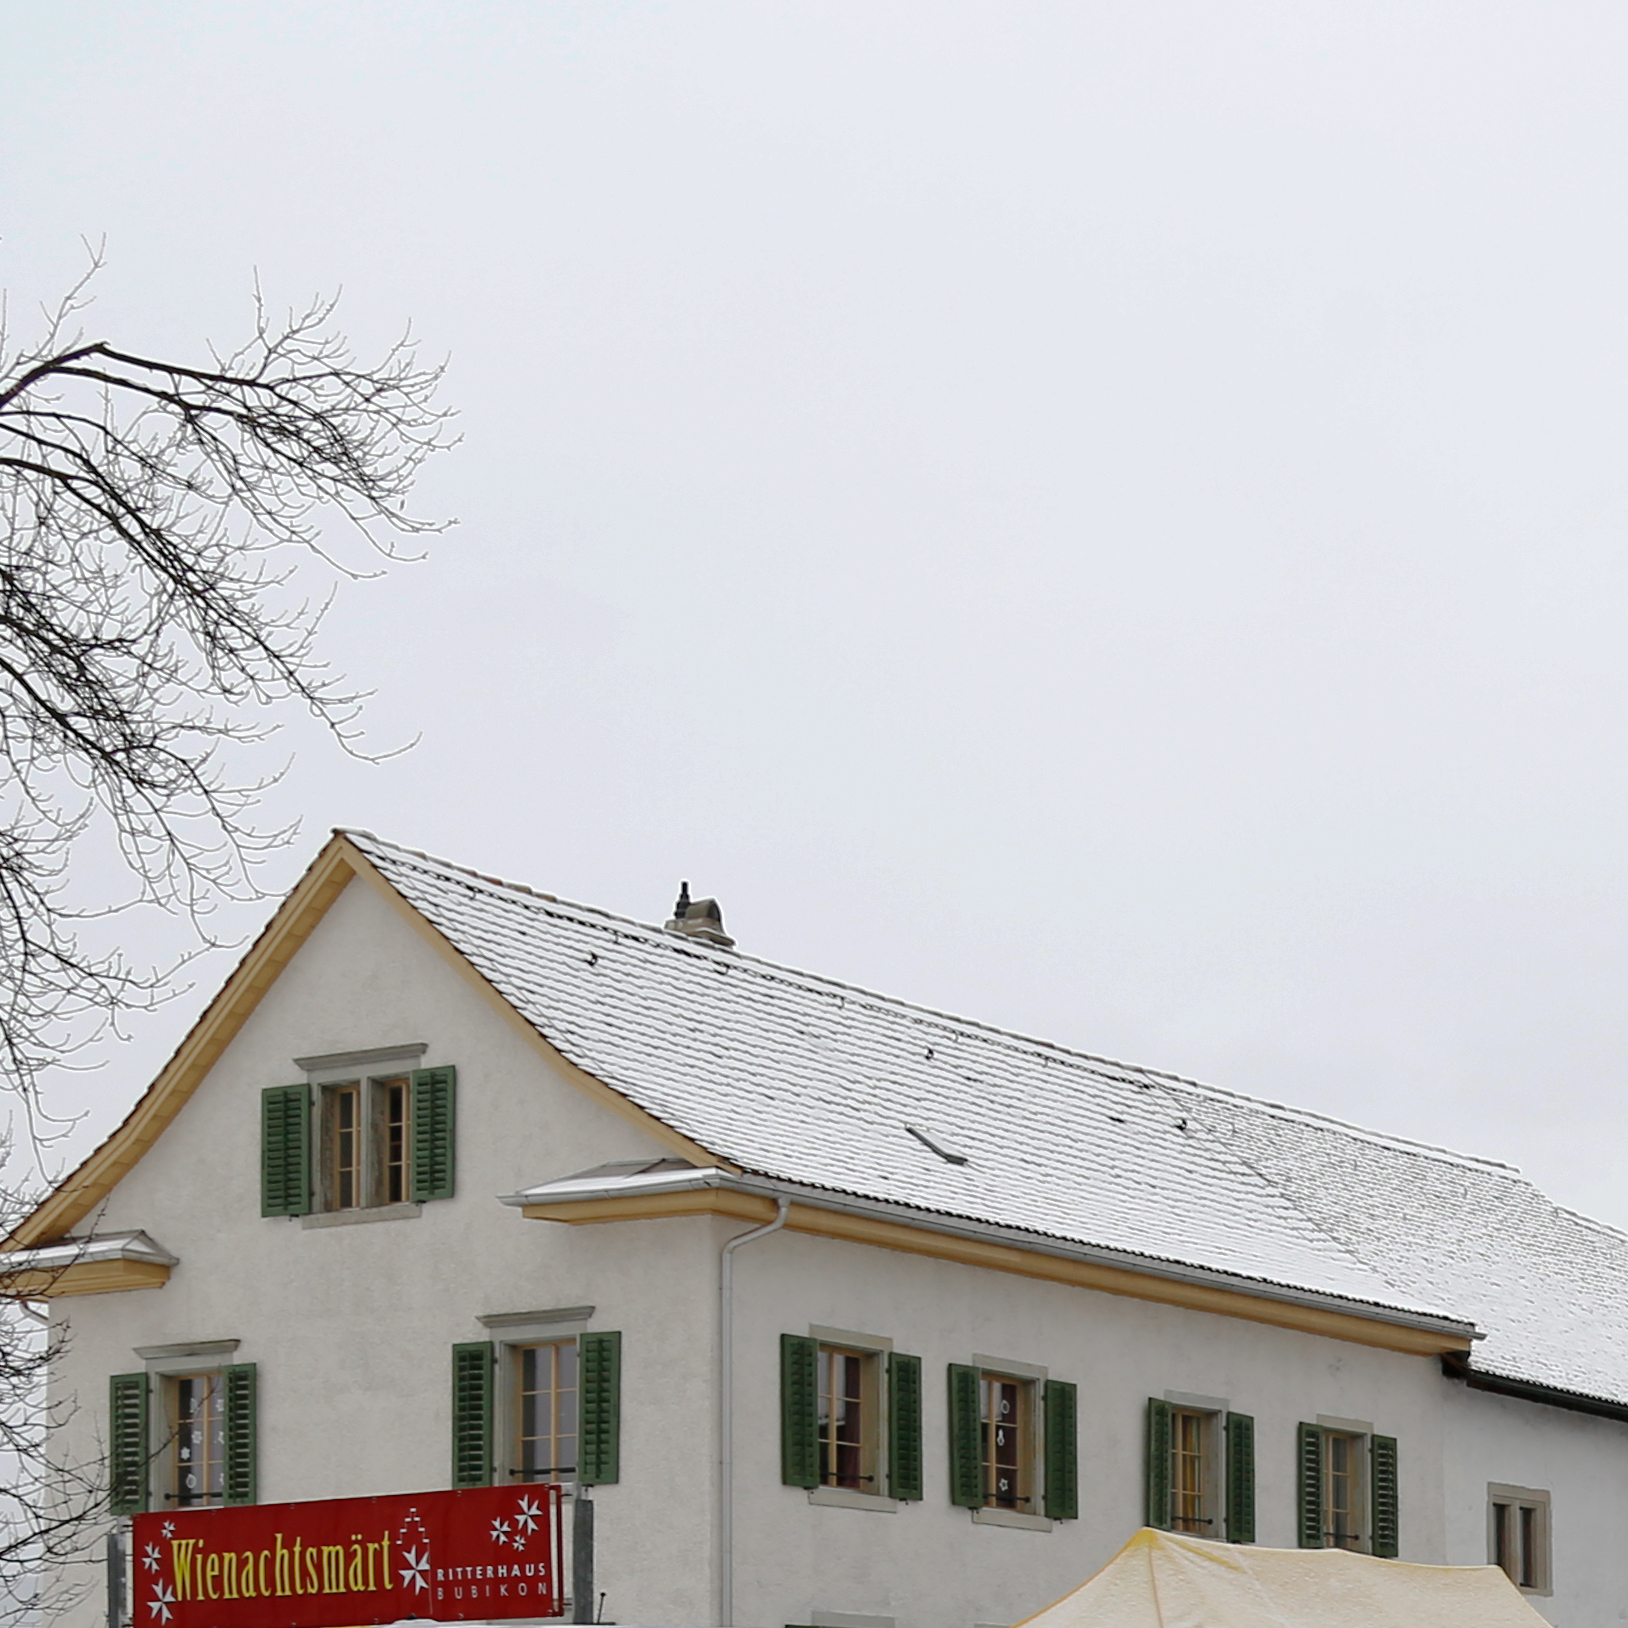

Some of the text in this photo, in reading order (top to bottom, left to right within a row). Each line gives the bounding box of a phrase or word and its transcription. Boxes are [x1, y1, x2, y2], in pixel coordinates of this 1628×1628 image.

[171, 1530, 394, 1601] Wienachtsmärt
[437, 1563, 546, 1581] RITTERHAUS
[437, 1582, 547, 1600] BUBIKON
